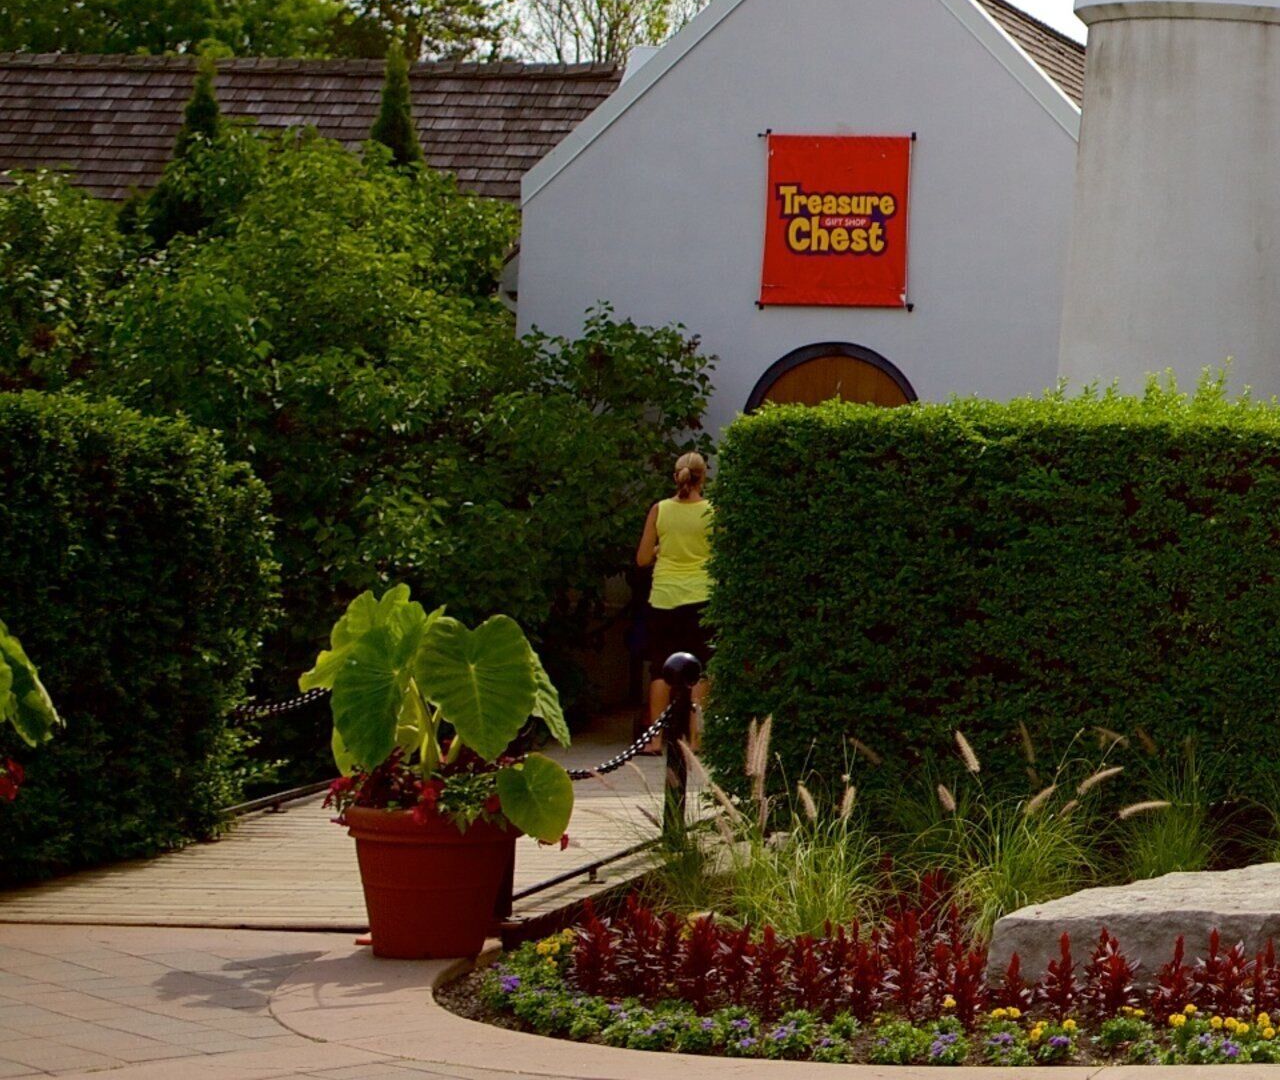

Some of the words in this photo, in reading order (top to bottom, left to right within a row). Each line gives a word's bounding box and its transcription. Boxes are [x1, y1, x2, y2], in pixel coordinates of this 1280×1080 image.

[779, 185, 895, 215] Treasure
[788, 215, 885, 252] Chest
[825, 217, 843, 226] GIFT
[844, 218, 867, 227] SHOP
